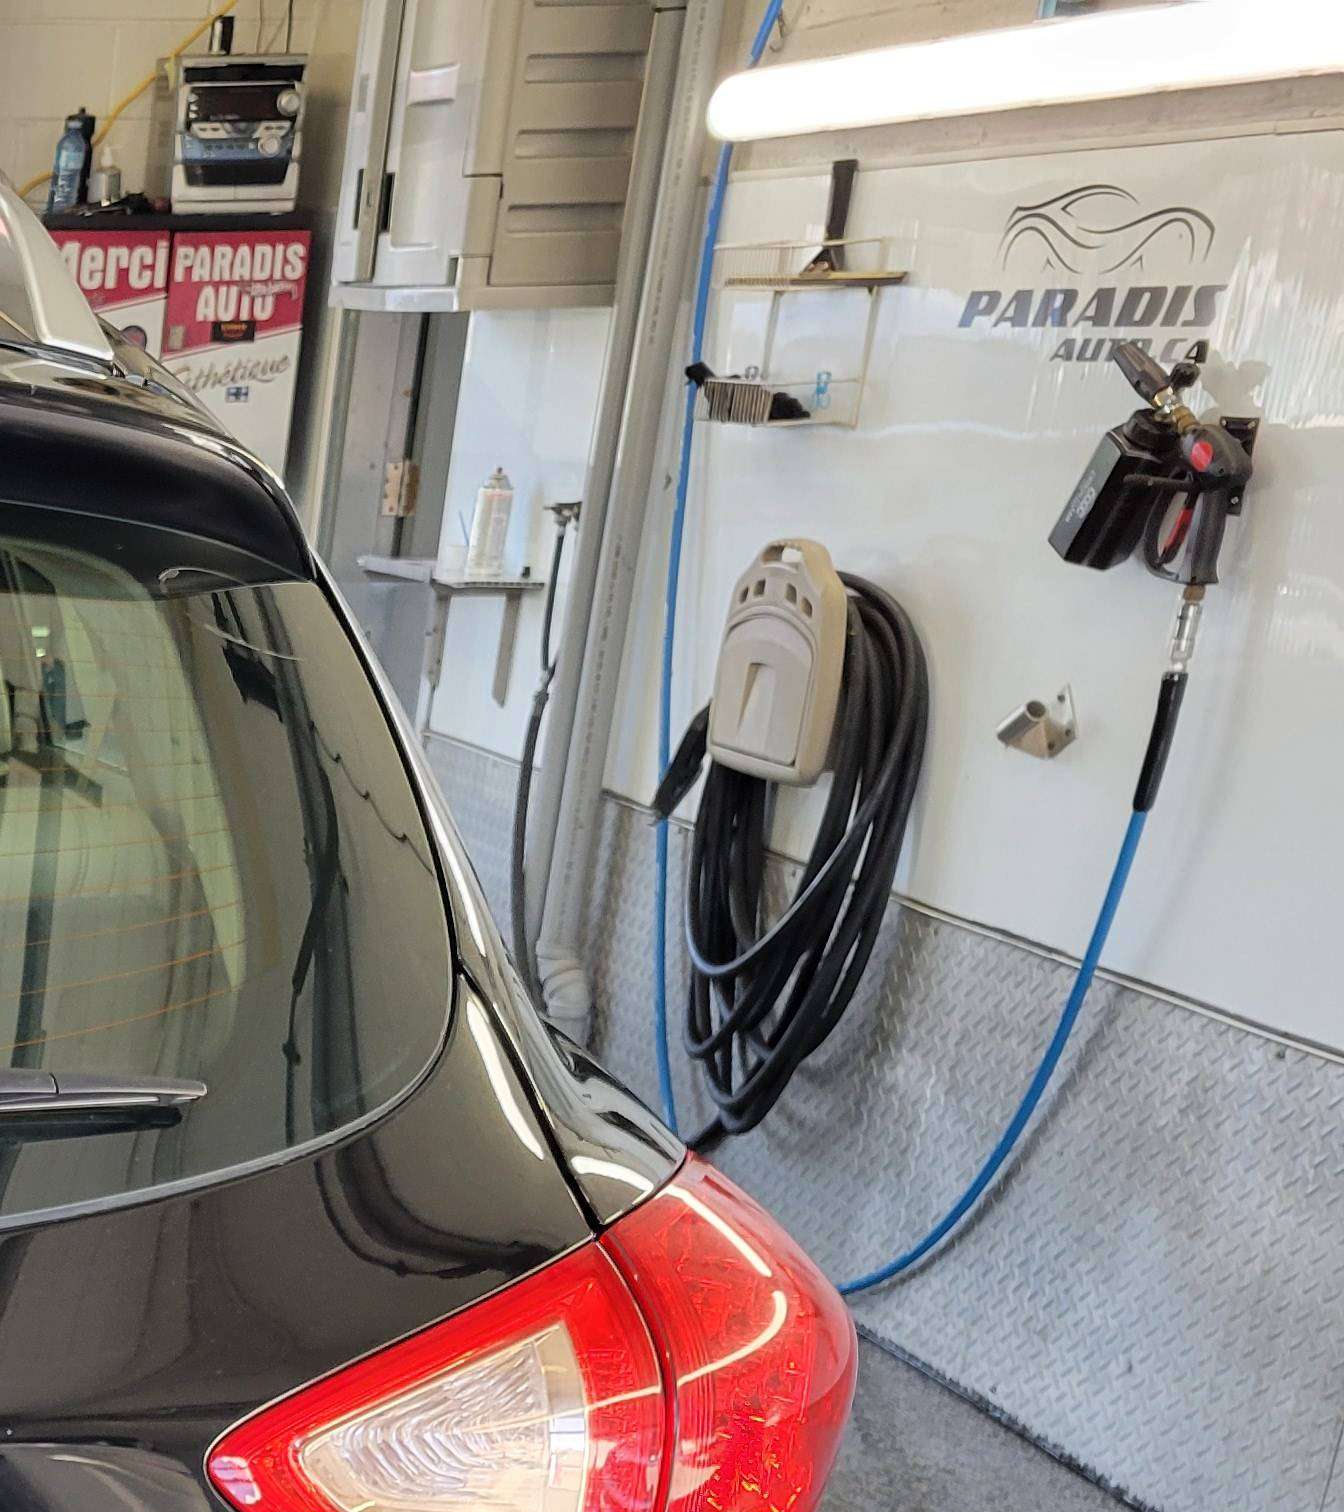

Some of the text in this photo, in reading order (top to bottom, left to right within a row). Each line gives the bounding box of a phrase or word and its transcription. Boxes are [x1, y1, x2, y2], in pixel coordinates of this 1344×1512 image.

[174, 242, 307, 282] PARADIS
[196, 284, 275, 322] AUTO
[957, 285, 1229, 328] PARADIS
[1050, 338, 1210, 364] AUTCA
